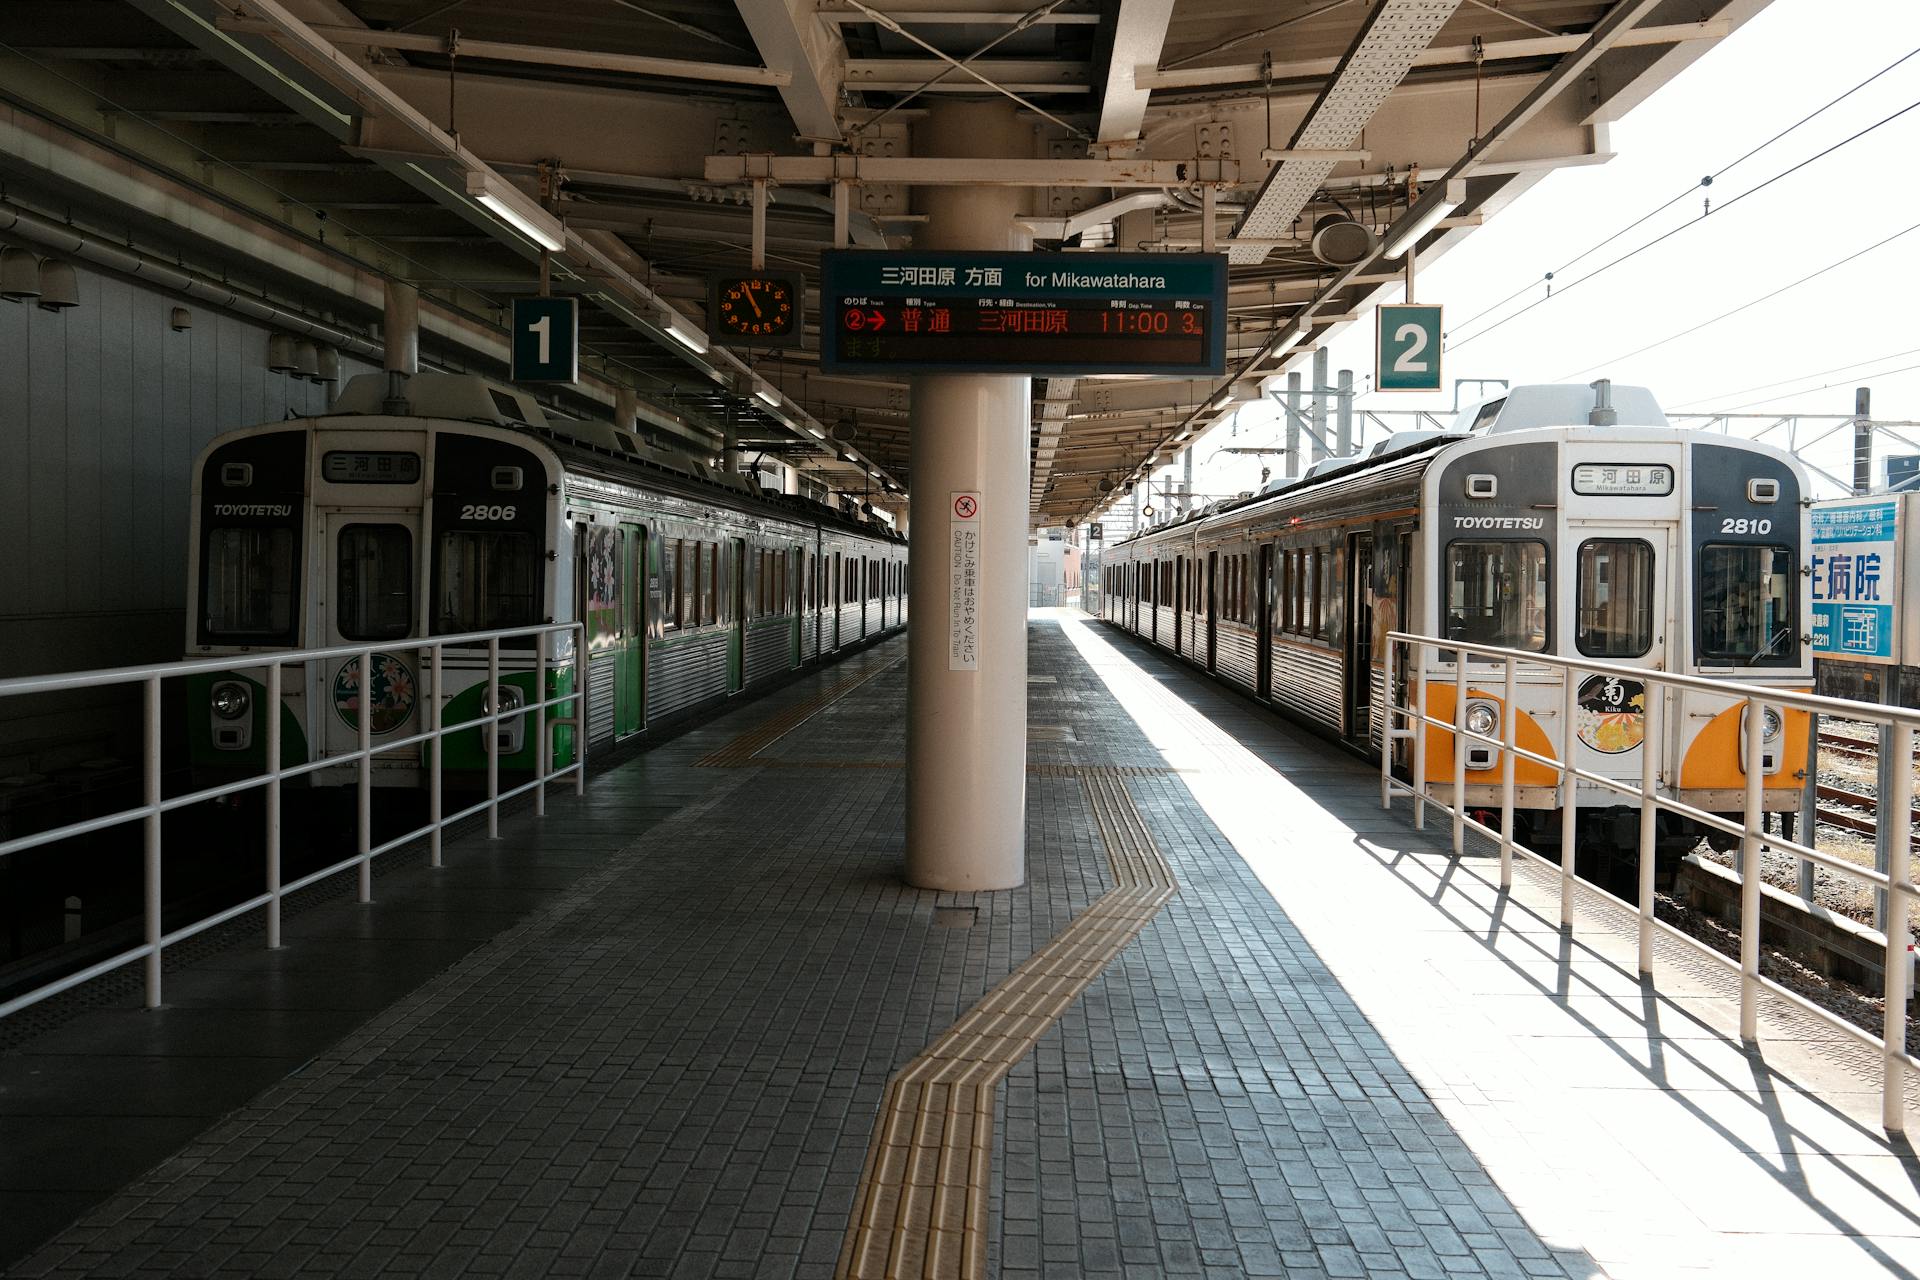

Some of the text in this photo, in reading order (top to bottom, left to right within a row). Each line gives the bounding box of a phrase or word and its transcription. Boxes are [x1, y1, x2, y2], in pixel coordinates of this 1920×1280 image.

[881, 266, 1003, 287] 三河田原 方面
[1025, 272, 1166, 289] for Mikawatahara
[844, 297, 868, 306] のりば
[977, 309, 1068, 334] 三河田原
[1101, 311, 1168, 333] 11:00
[528, 316, 550, 364] 1
[1393, 323, 1428, 372] 2
[332, 457, 415, 473] 三河田原
[1579, 469, 1666, 485] 三河田原
[213, 504, 292, 517] TOYOTETSU
[460, 505, 517, 520] 2806
[1092, 526, 1101, 537] 2
[1453, 517, 1543, 530] TOYOTETSU
[1721, 518, 1772, 535] 2810
[954, 530, 962, 568] CAUTION
[964, 530, 976, 663] かけこみ乗車はおやめください
[953, 602, 961, 618] Run
